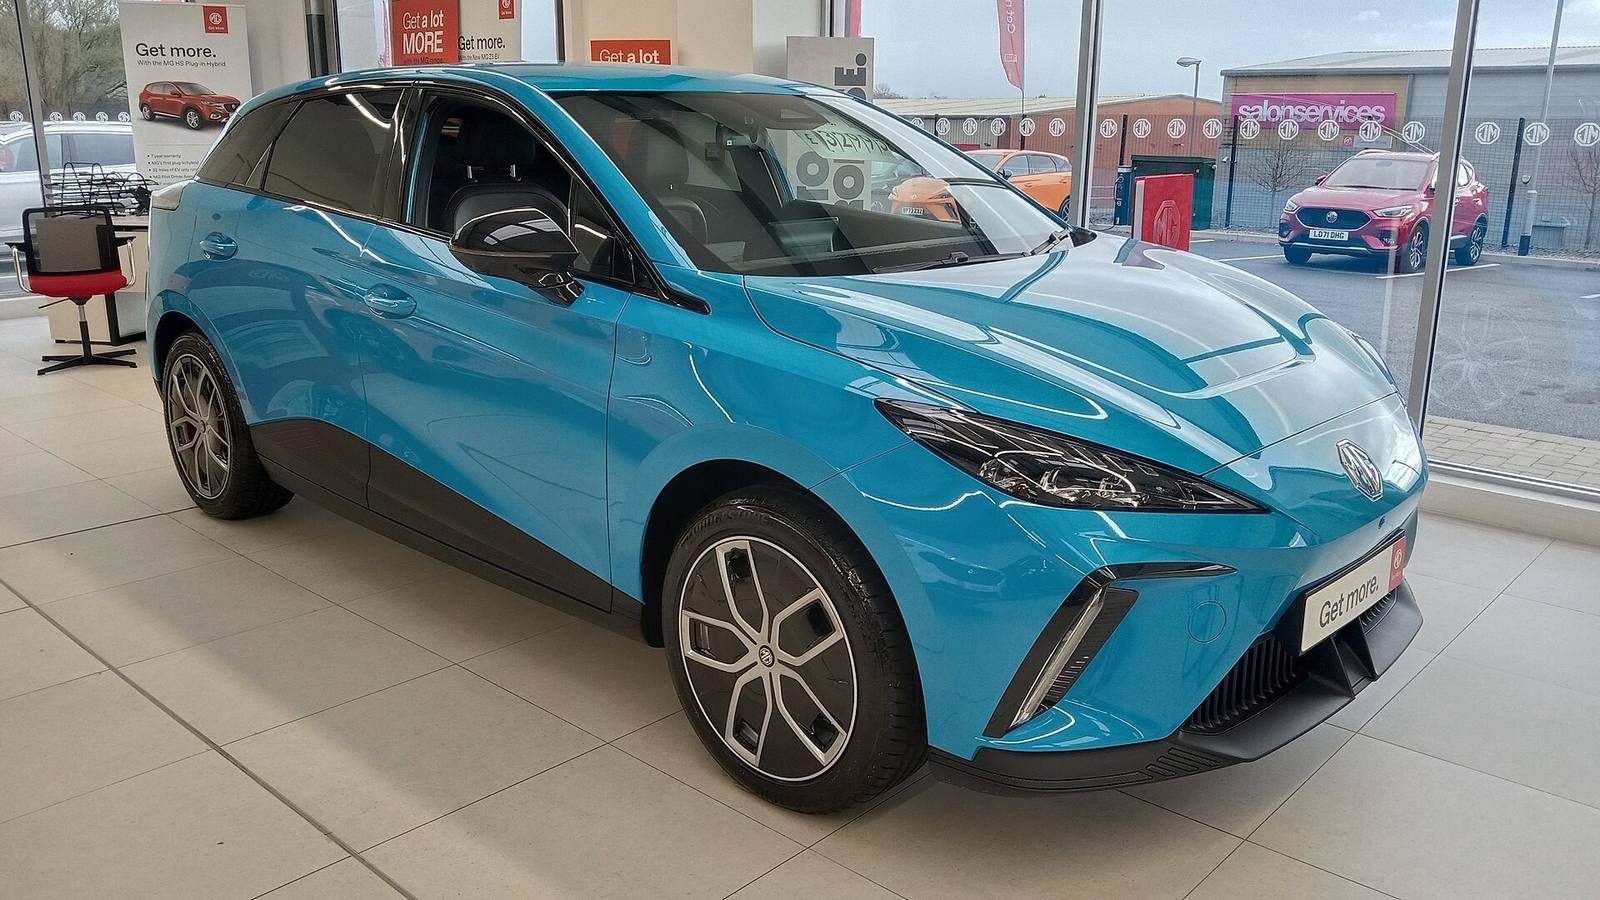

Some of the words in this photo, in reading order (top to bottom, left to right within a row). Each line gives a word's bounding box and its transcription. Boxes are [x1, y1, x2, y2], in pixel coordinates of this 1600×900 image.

[403, 12, 421, 30] Get
[421, 17, 428, 28] a
[430, 10, 444, 28] lot
[136, 43, 166, 57] Get
[170, 46, 217, 58] more.
[403, 31, 444, 55] MORE
[458, 35, 474, 51] Get
[477, 37, 506, 50] more.
[207, 60, 226, 68] Hybrid
[600, 49, 623, 62] Get
[627, 53, 636, 63] a
[639, 49, 660, 64] lot
[1238, 99, 1386, 123] salonservices
[1313, 230, 1329, 238] LD71
[1337, 441, 1383, 500] MG
[1319, 592, 1345, 628] Get
[1345, 575, 1379, 612] more.
